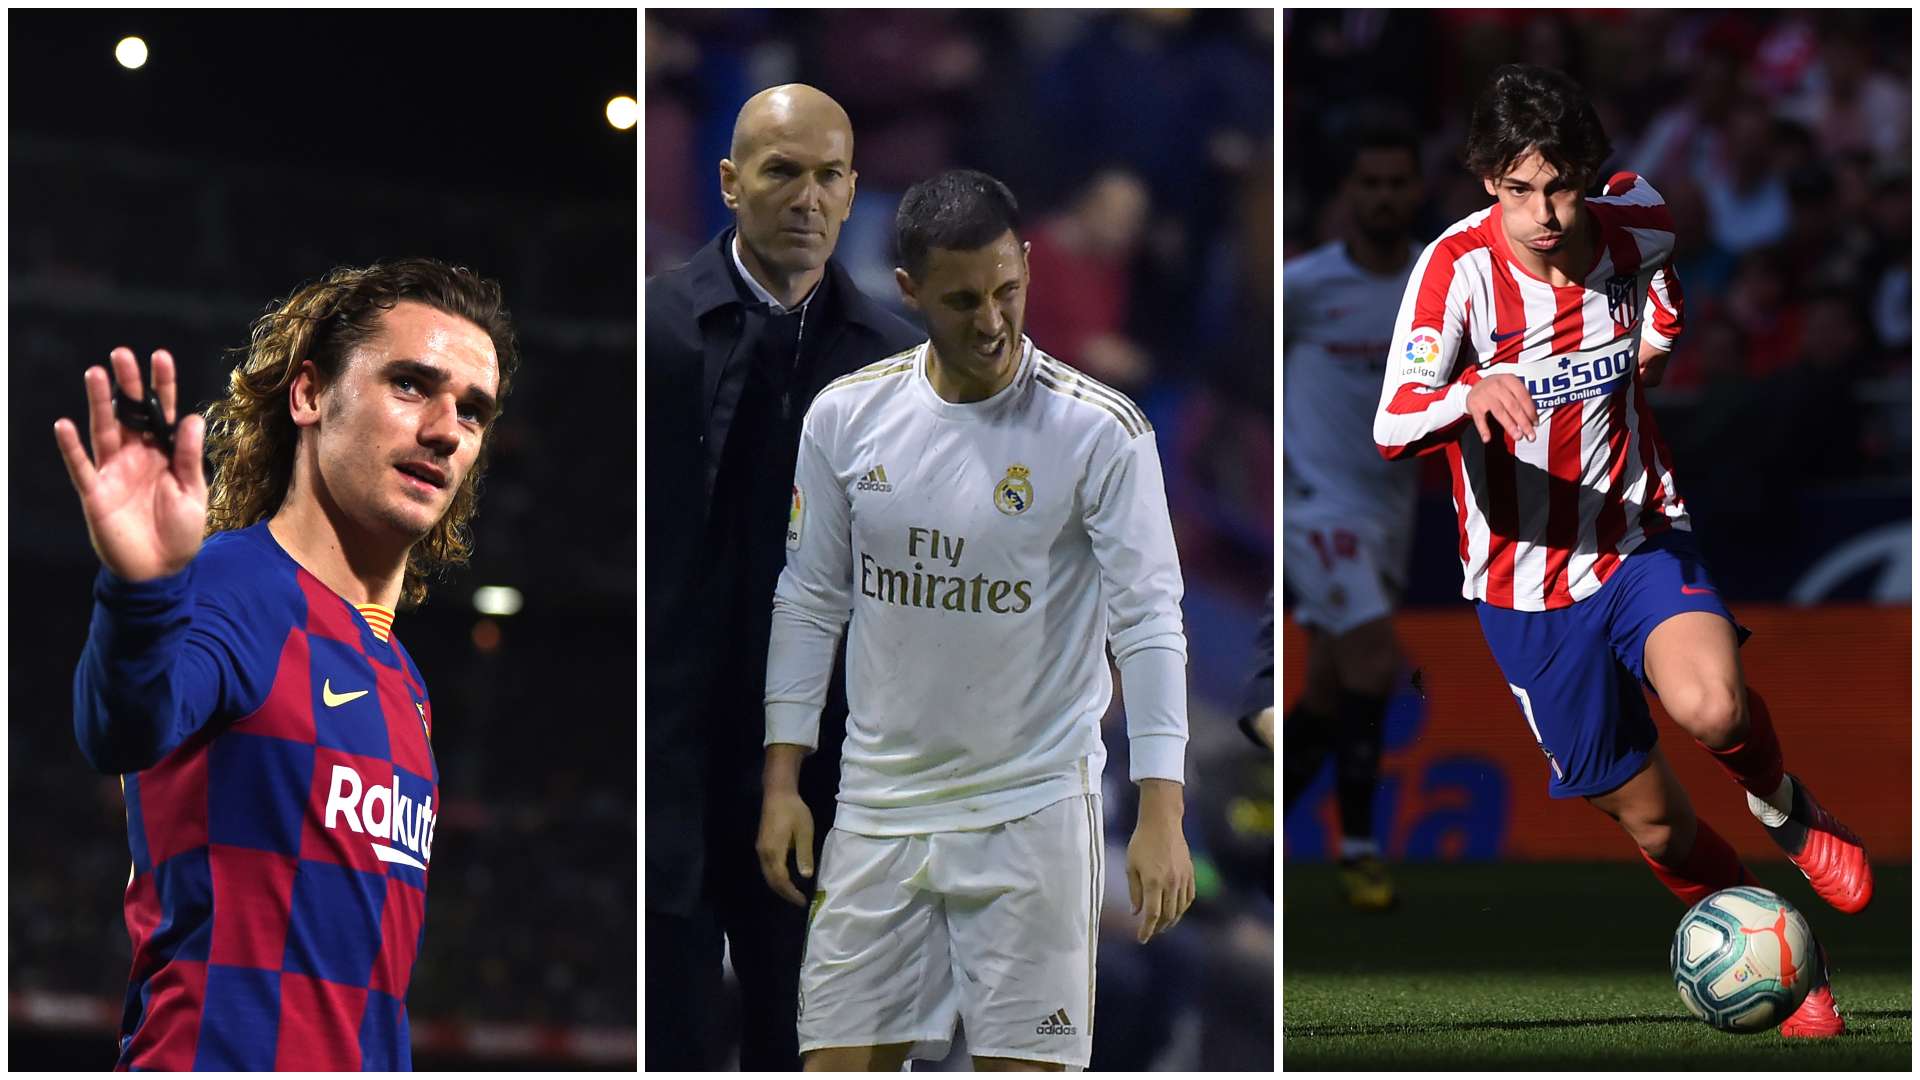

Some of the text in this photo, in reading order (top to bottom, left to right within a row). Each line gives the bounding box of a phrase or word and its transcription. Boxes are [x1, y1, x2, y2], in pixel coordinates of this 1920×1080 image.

[1519, 349, 1631, 396] us500
[1537, 386, 1602, 408] Trade Online
[857, 481, 892, 492] adidas
[909, 527, 965, 567] Fly
[861, 552, 1032, 613] Emirates
[1036, 1025, 1077, 1036] adidas
